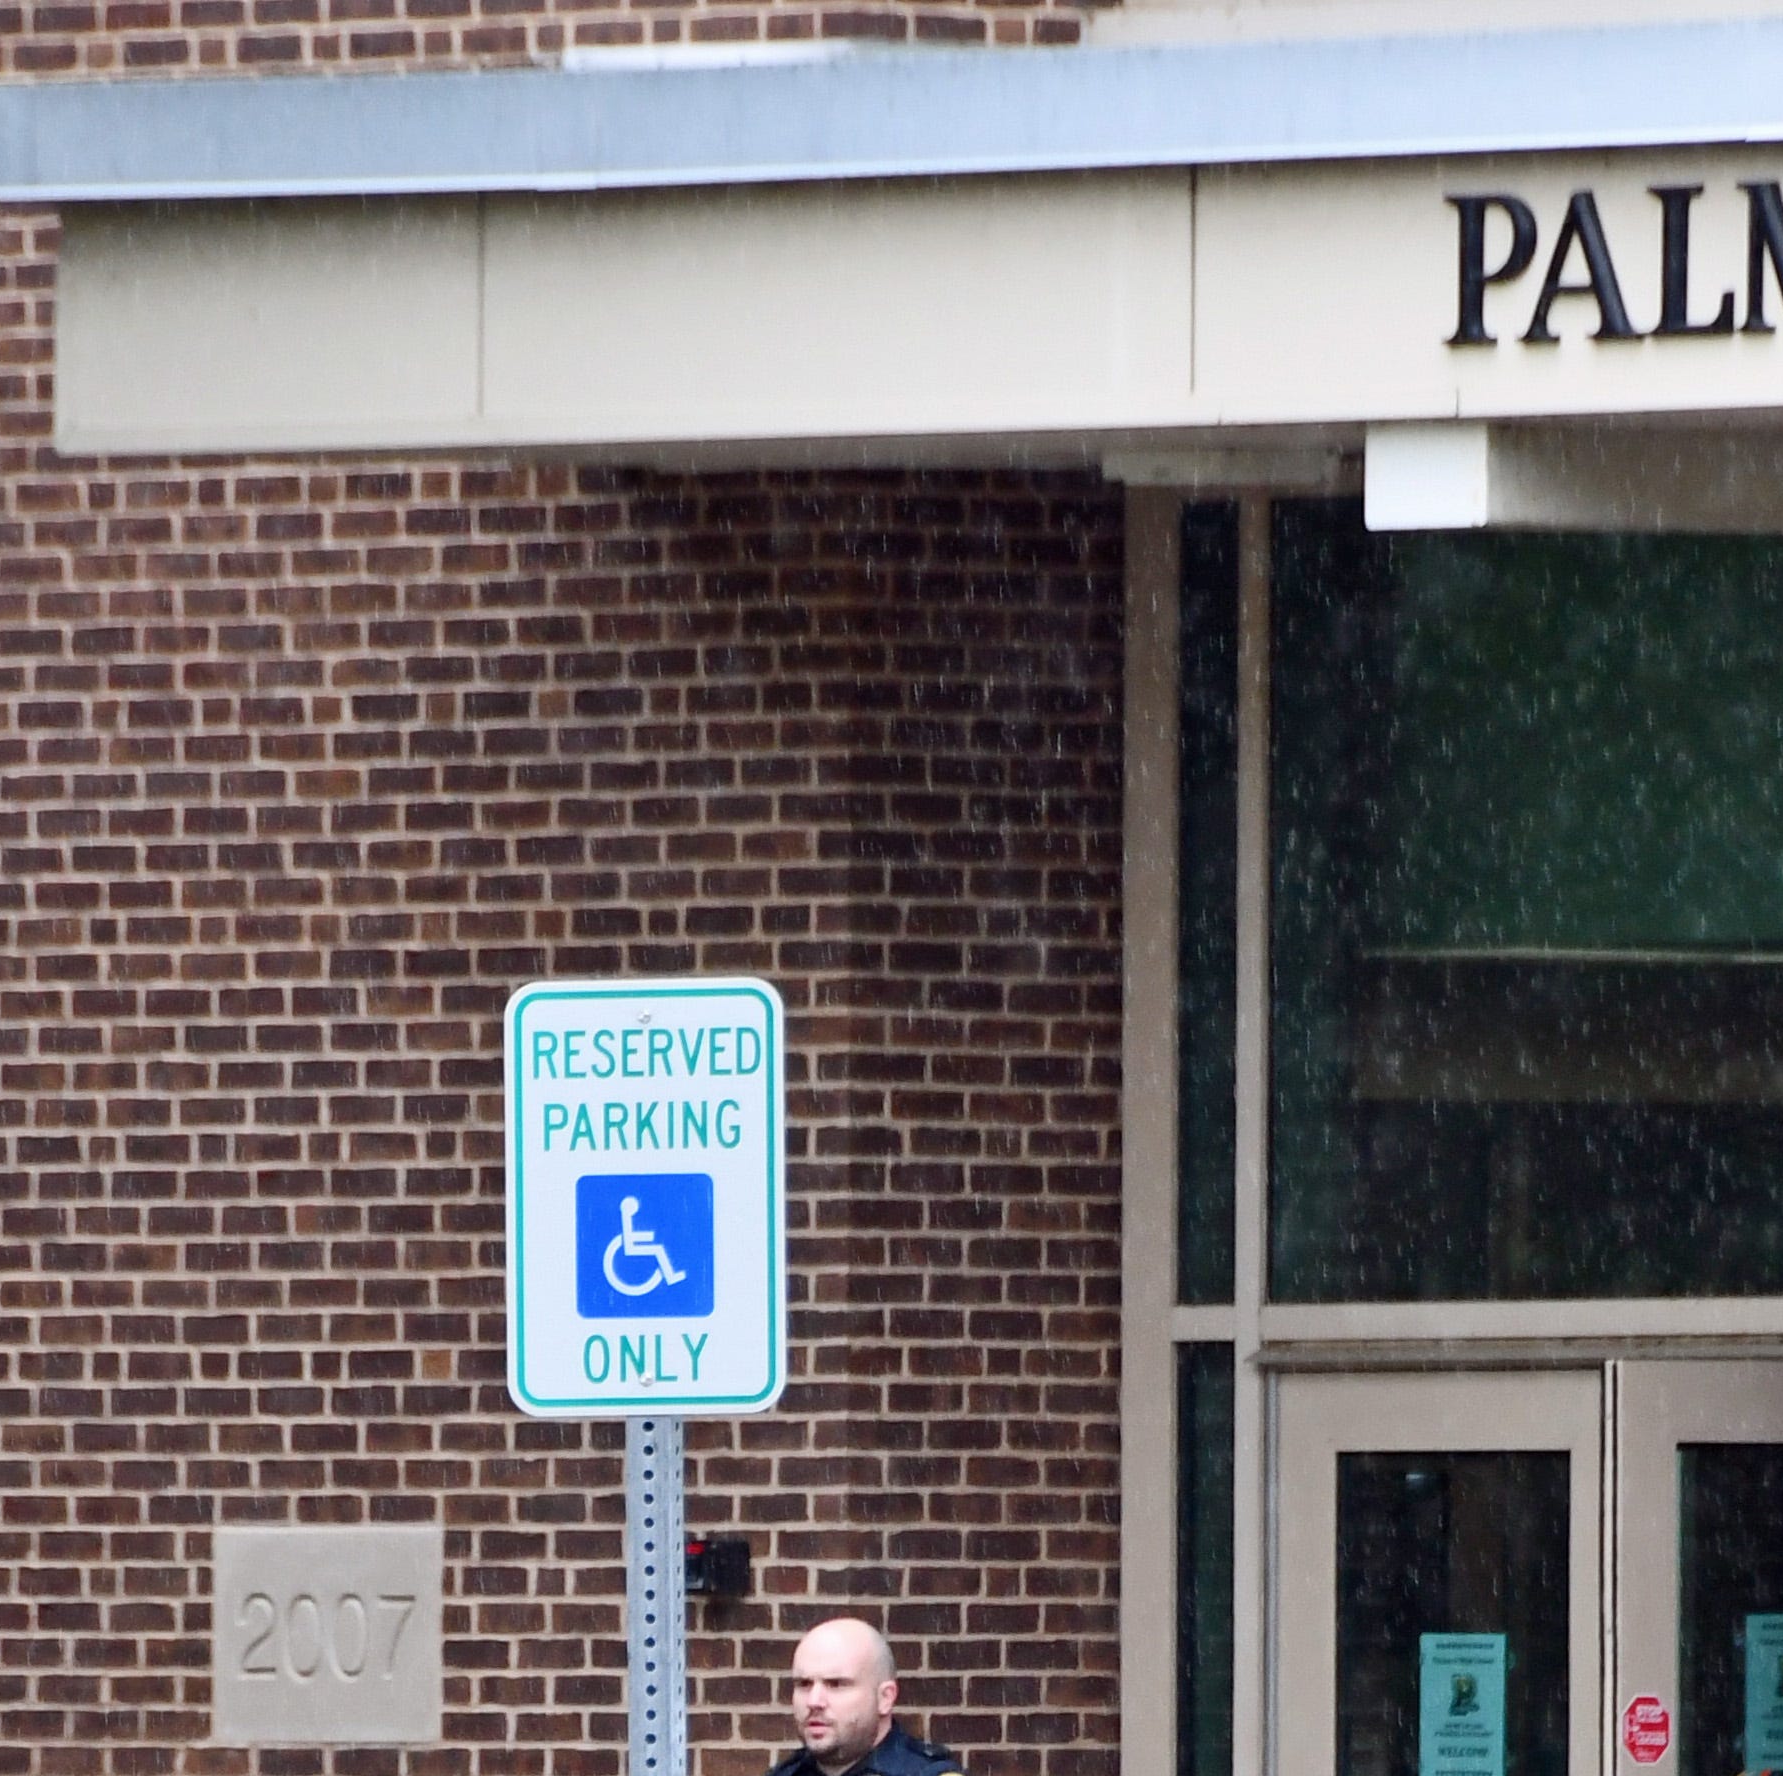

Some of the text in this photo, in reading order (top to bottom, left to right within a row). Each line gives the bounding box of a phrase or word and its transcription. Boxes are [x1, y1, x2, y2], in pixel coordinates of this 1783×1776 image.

[531, 1027, 762, 1079] RESERVED
[543, 1099, 742, 1151] PARKING
[584, 1333, 709, 1383] ONLY
[235, 1592, 416, 1683] 2007
